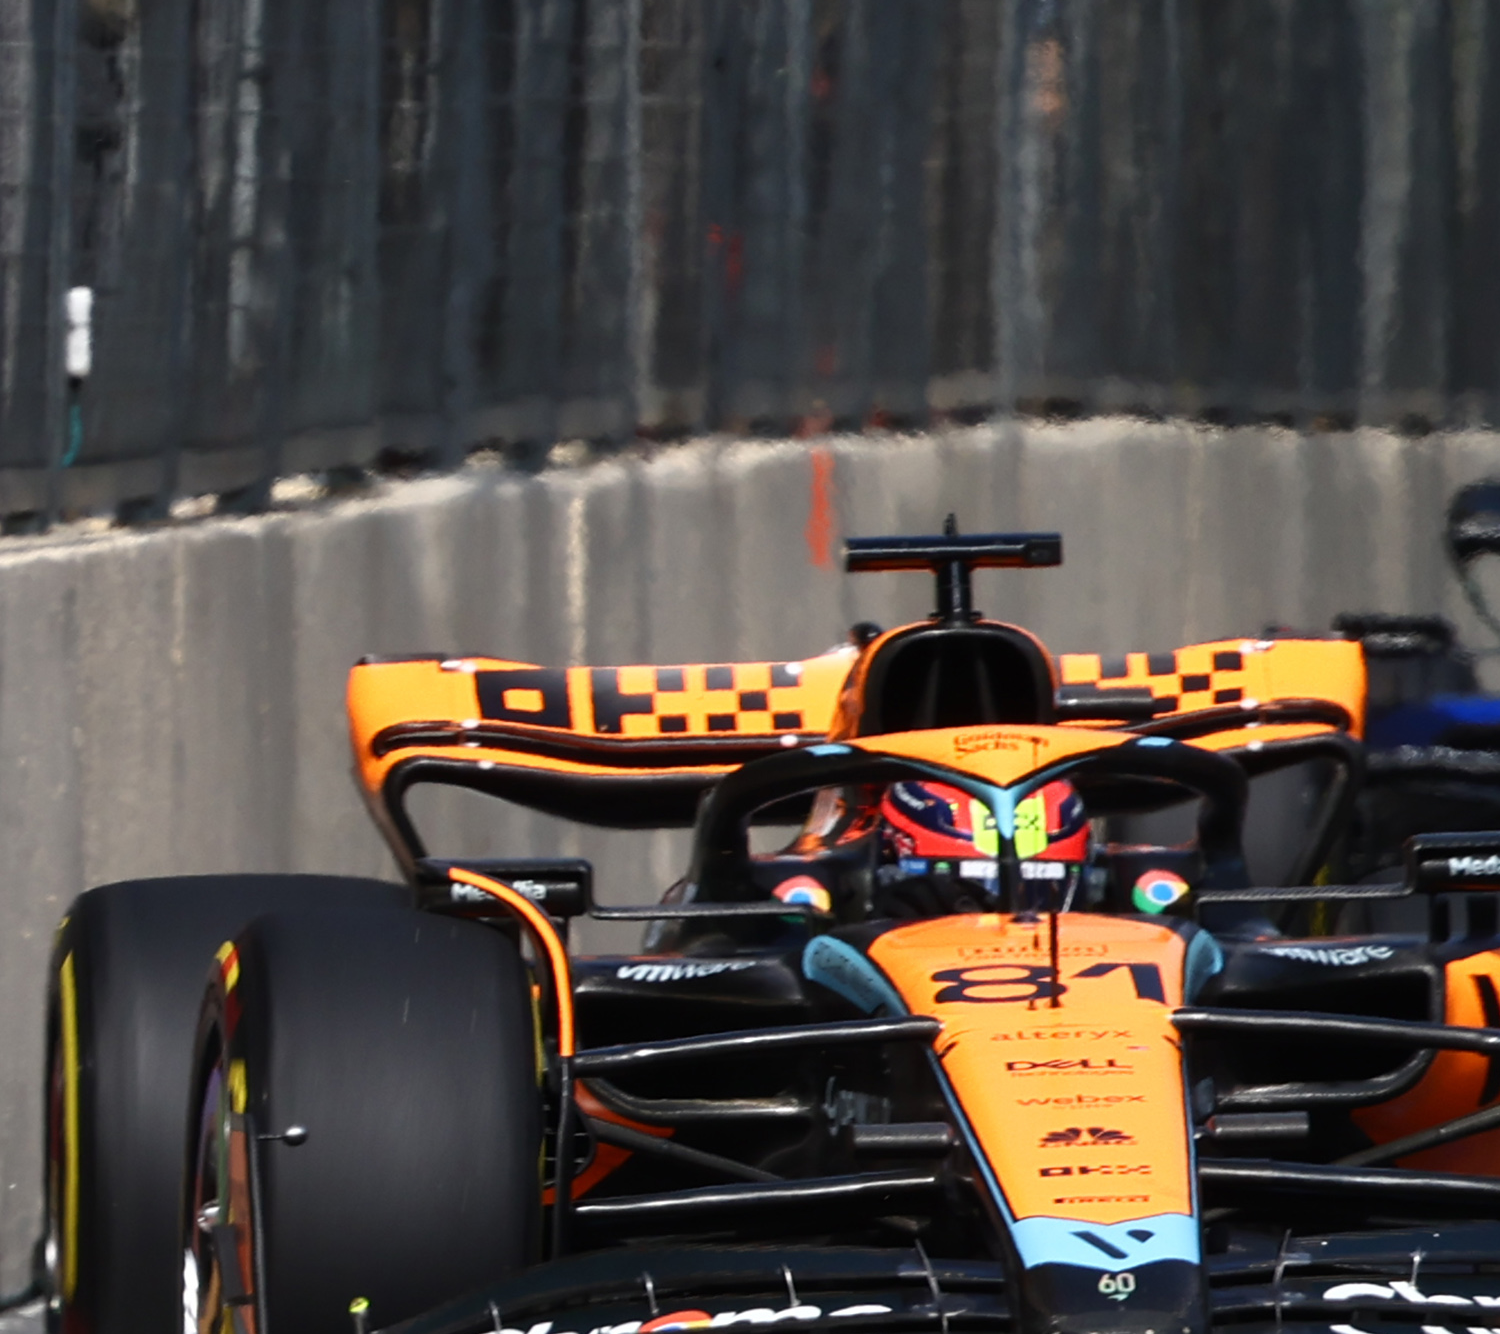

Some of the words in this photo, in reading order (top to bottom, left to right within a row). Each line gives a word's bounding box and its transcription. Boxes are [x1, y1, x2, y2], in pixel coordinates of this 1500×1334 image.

[932, 963, 1170, 1004] 81
[989, 1030, 1133, 1041] alteryx
[1097, 1273, 1136, 1294] 60
